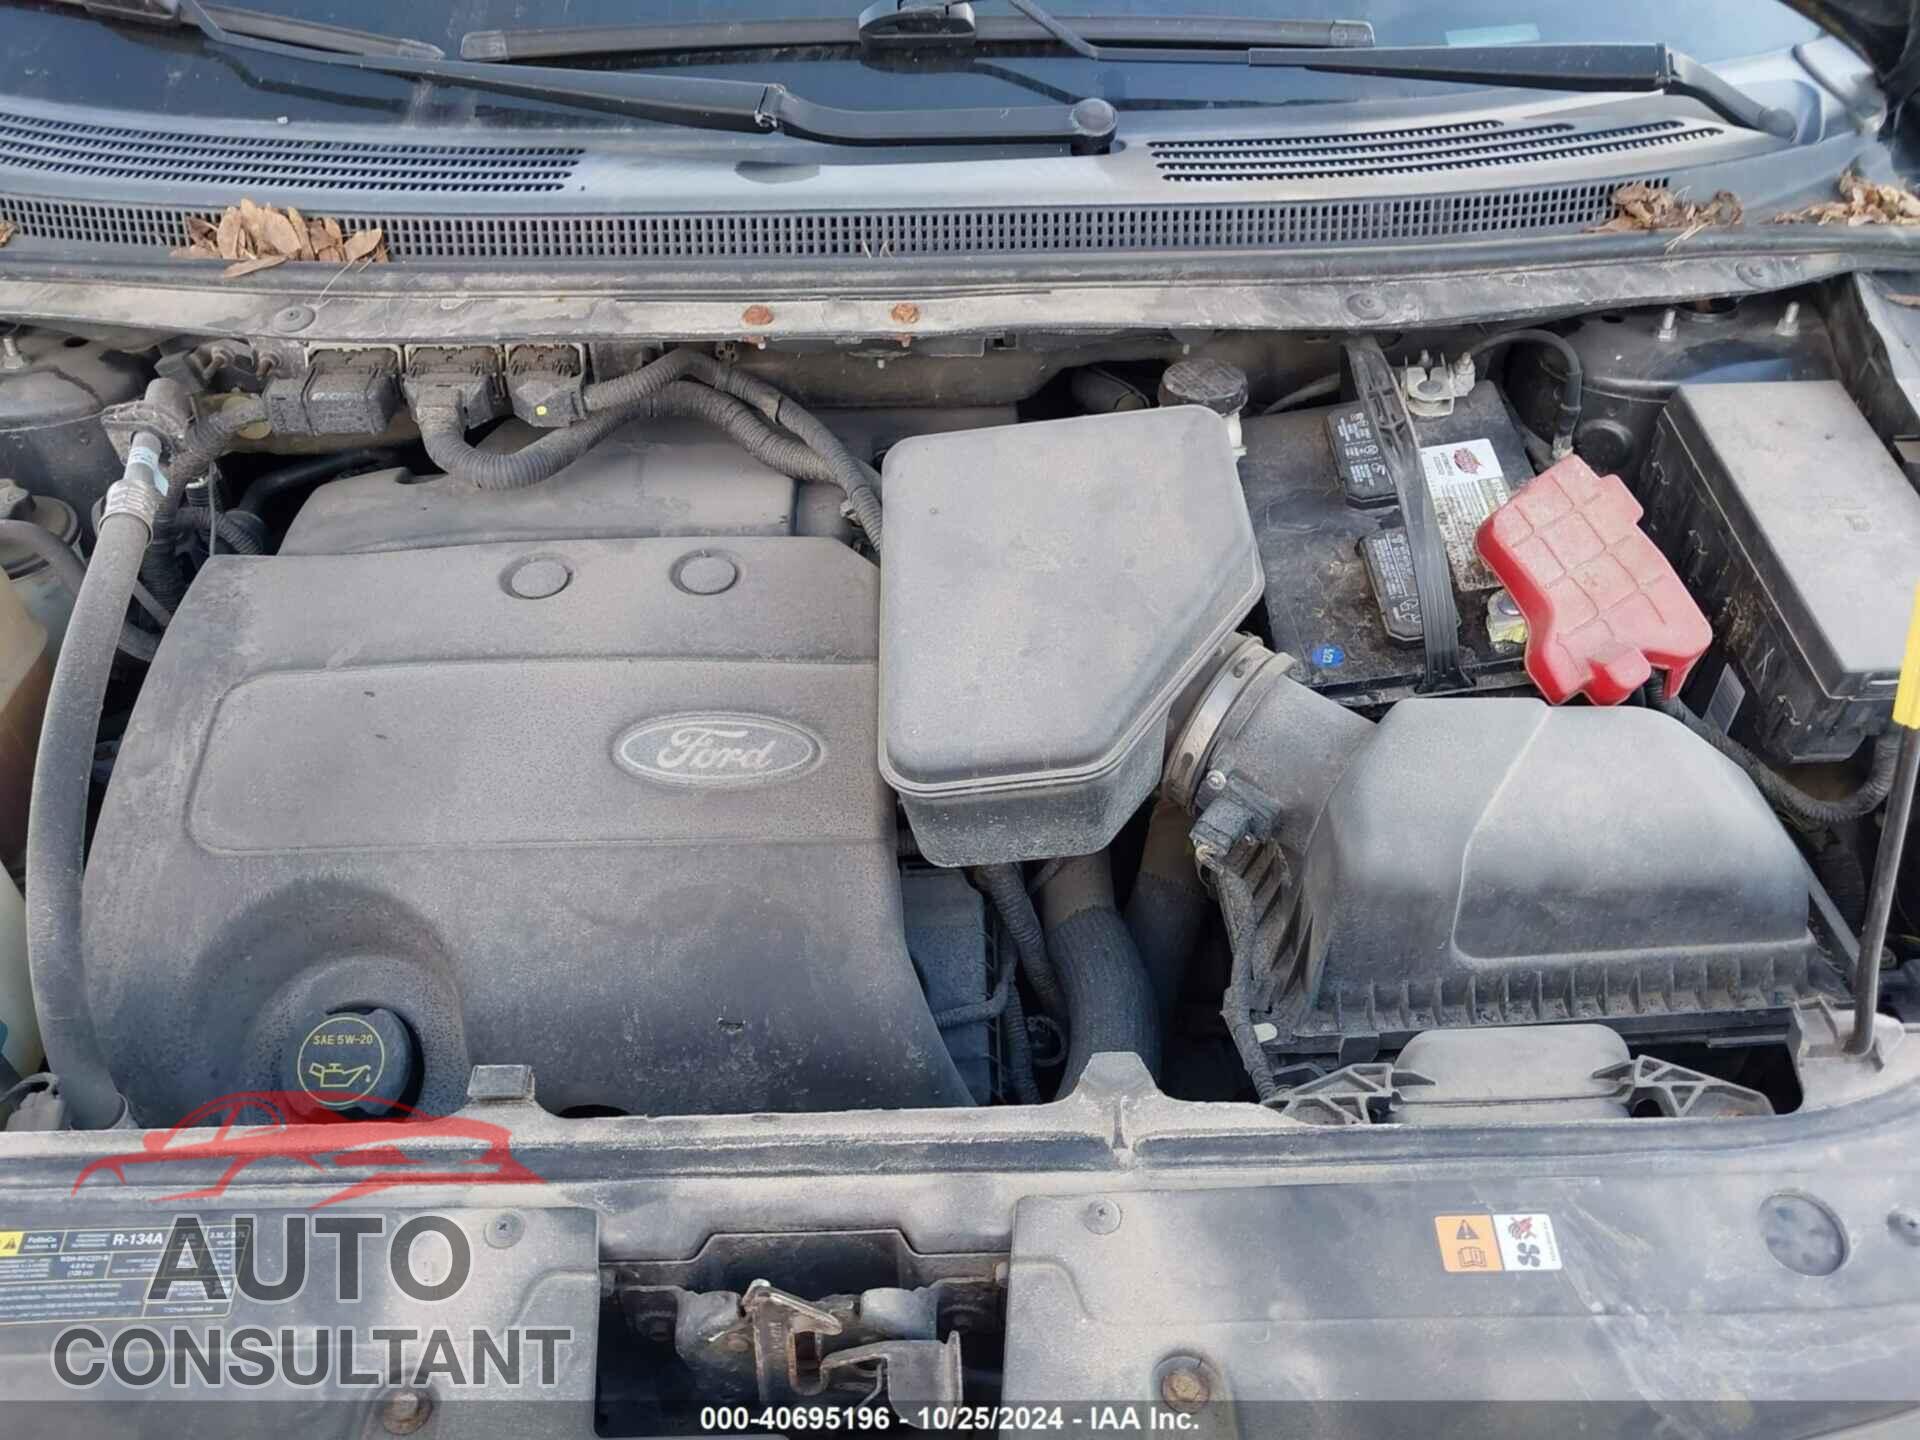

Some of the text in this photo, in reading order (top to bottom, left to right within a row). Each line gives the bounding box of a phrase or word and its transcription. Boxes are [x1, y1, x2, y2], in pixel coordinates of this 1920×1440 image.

[656, 726, 777, 769] Ford
[313, 1034, 373, 1045] SAE 5W-20
[112, 1232, 163, 1246] R-134A
